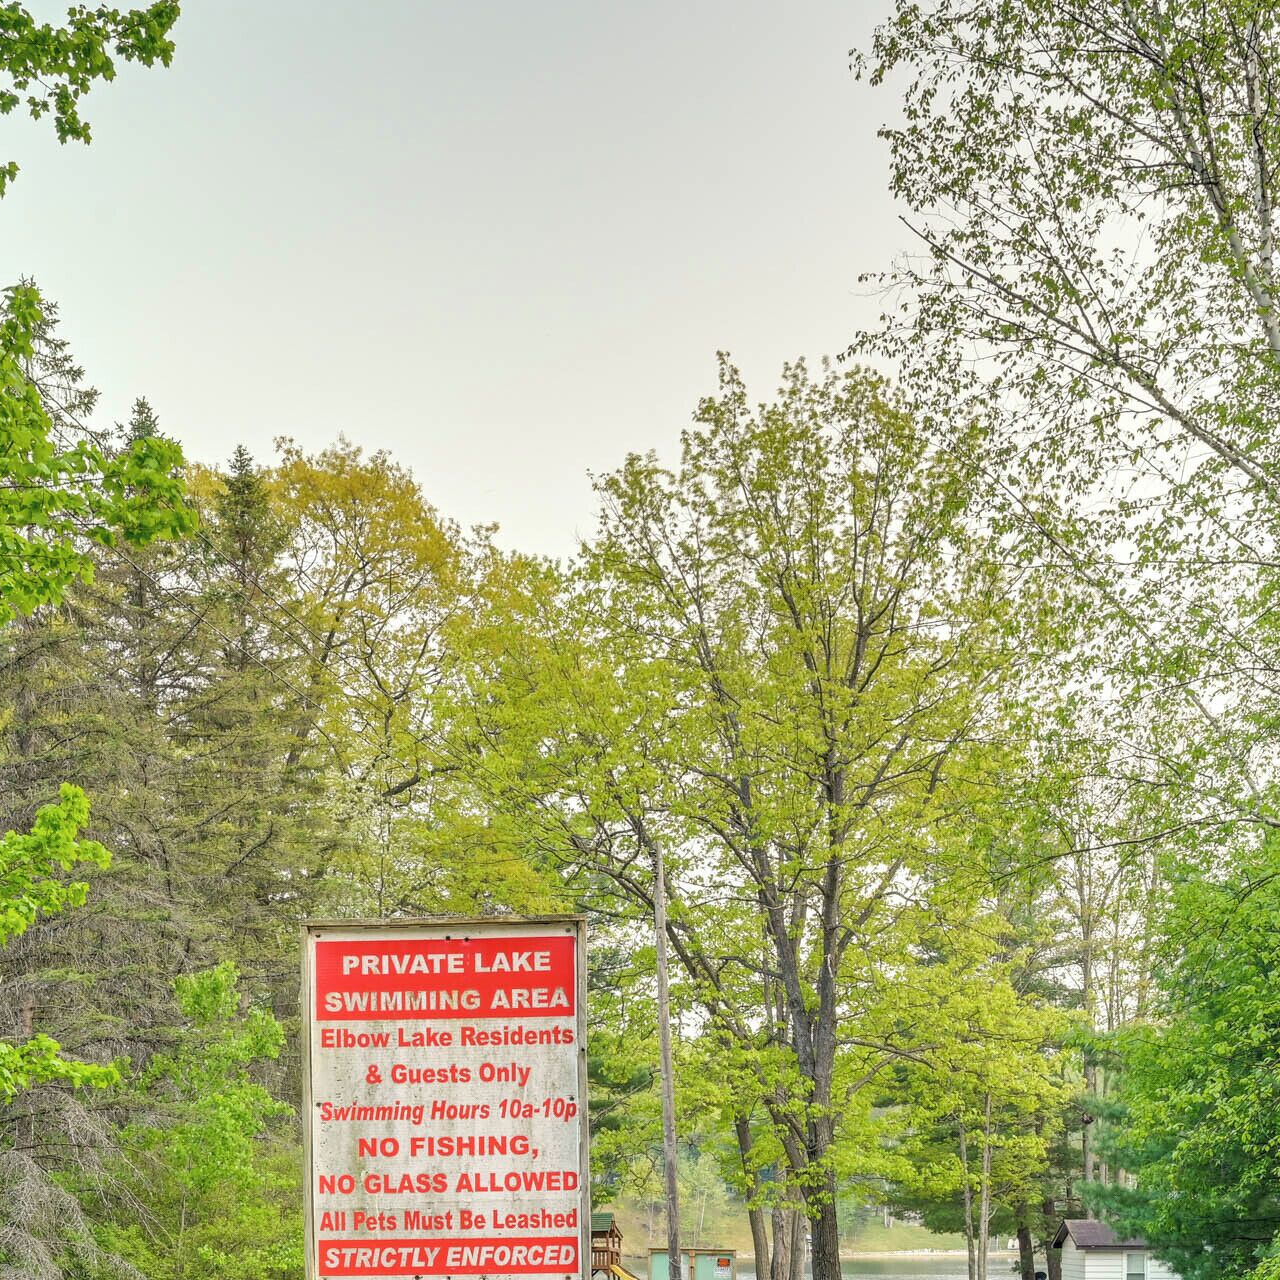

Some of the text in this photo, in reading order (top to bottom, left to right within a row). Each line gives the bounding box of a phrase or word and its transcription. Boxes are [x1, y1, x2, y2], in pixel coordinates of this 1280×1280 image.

[343, 951, 550, 974] PRIVATE LAKE
[326, 988, 569, 1011] SWIMMING AREA
[321, 1025, 574, 1049] Elbow Lake Residents
[365, 1062, 532, 1087] & Guests Only
[320, 1098, 576, 1126] Swimming Hours 10a-10p
[358, 1135, 539, 1159] NO FISHING,
[319, 1171, 578, 1195] NO GLASS ALLOWED
[320, 1208, 577, 1232] All Pets Must Be Leashed
[326, 1245, 575, 1267] STRICTLY ENFORCED
